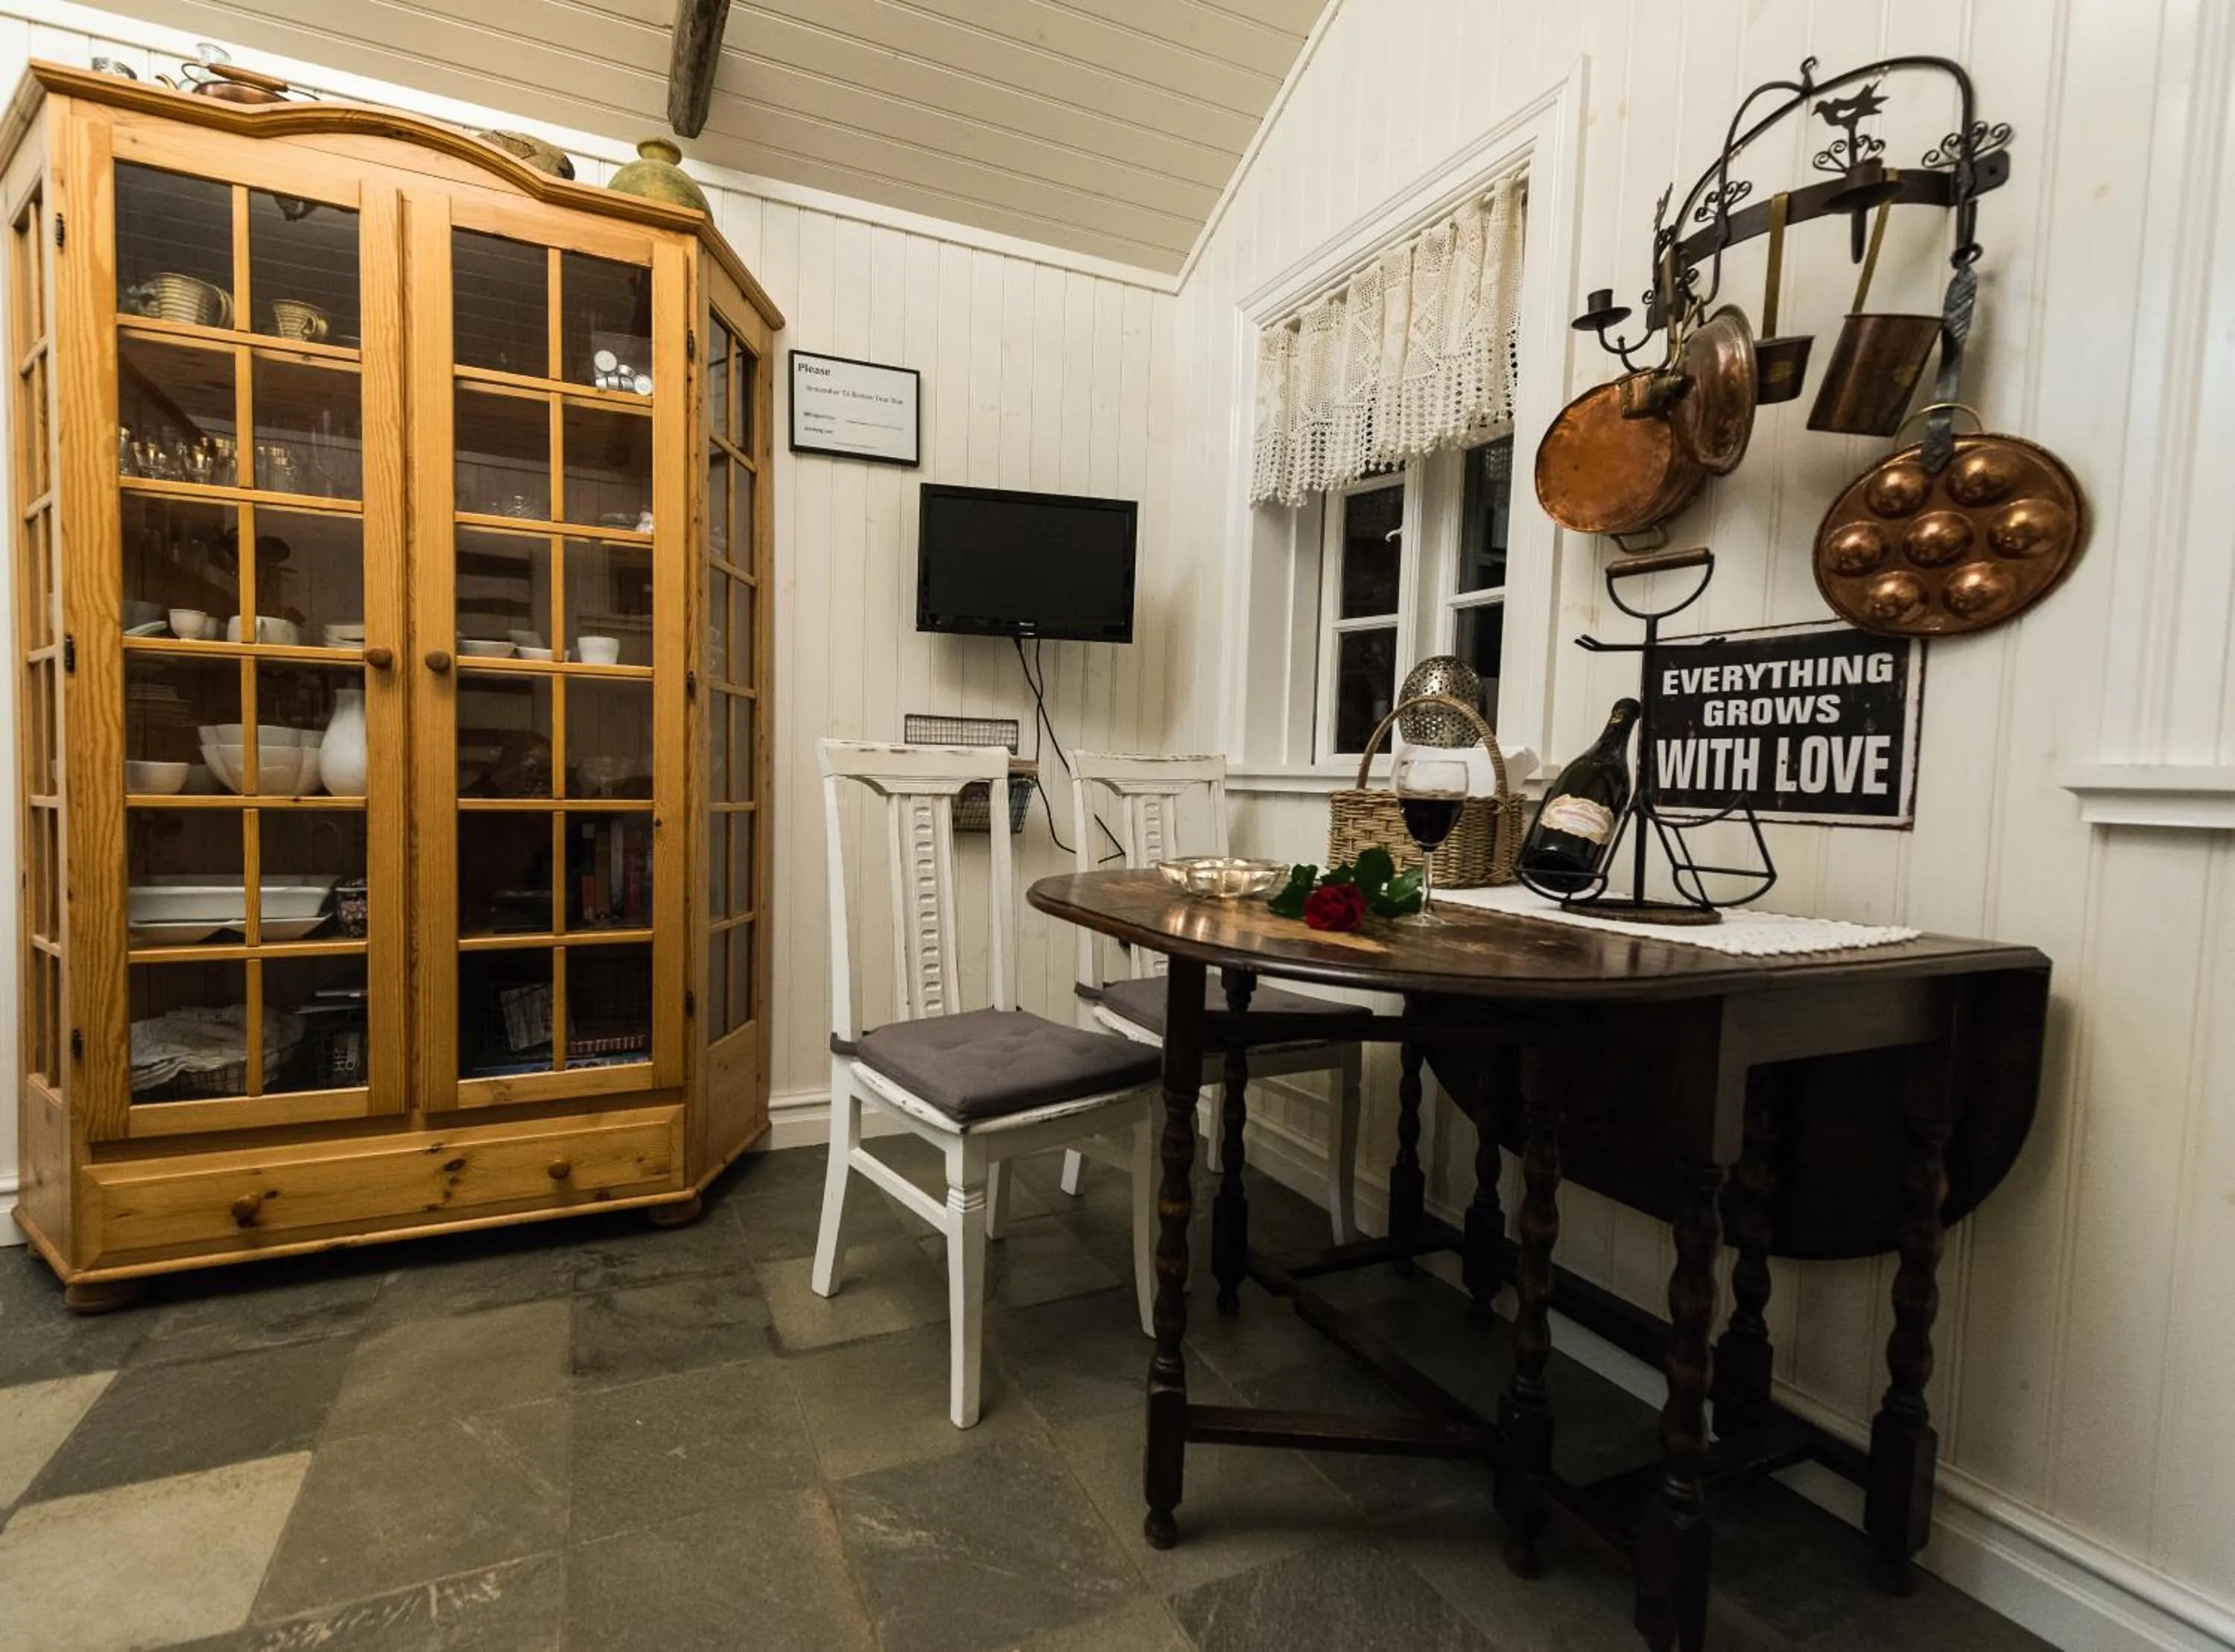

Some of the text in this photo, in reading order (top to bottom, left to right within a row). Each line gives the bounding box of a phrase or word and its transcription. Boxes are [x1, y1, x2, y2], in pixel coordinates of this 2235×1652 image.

[798, 363, 831, 376] Please
[1662, 652, 1894, 696] EVERYTHING
[1703, 694, 1841, 727] GROWS
[1656, 735, 1891, 795] WITH LOVE
